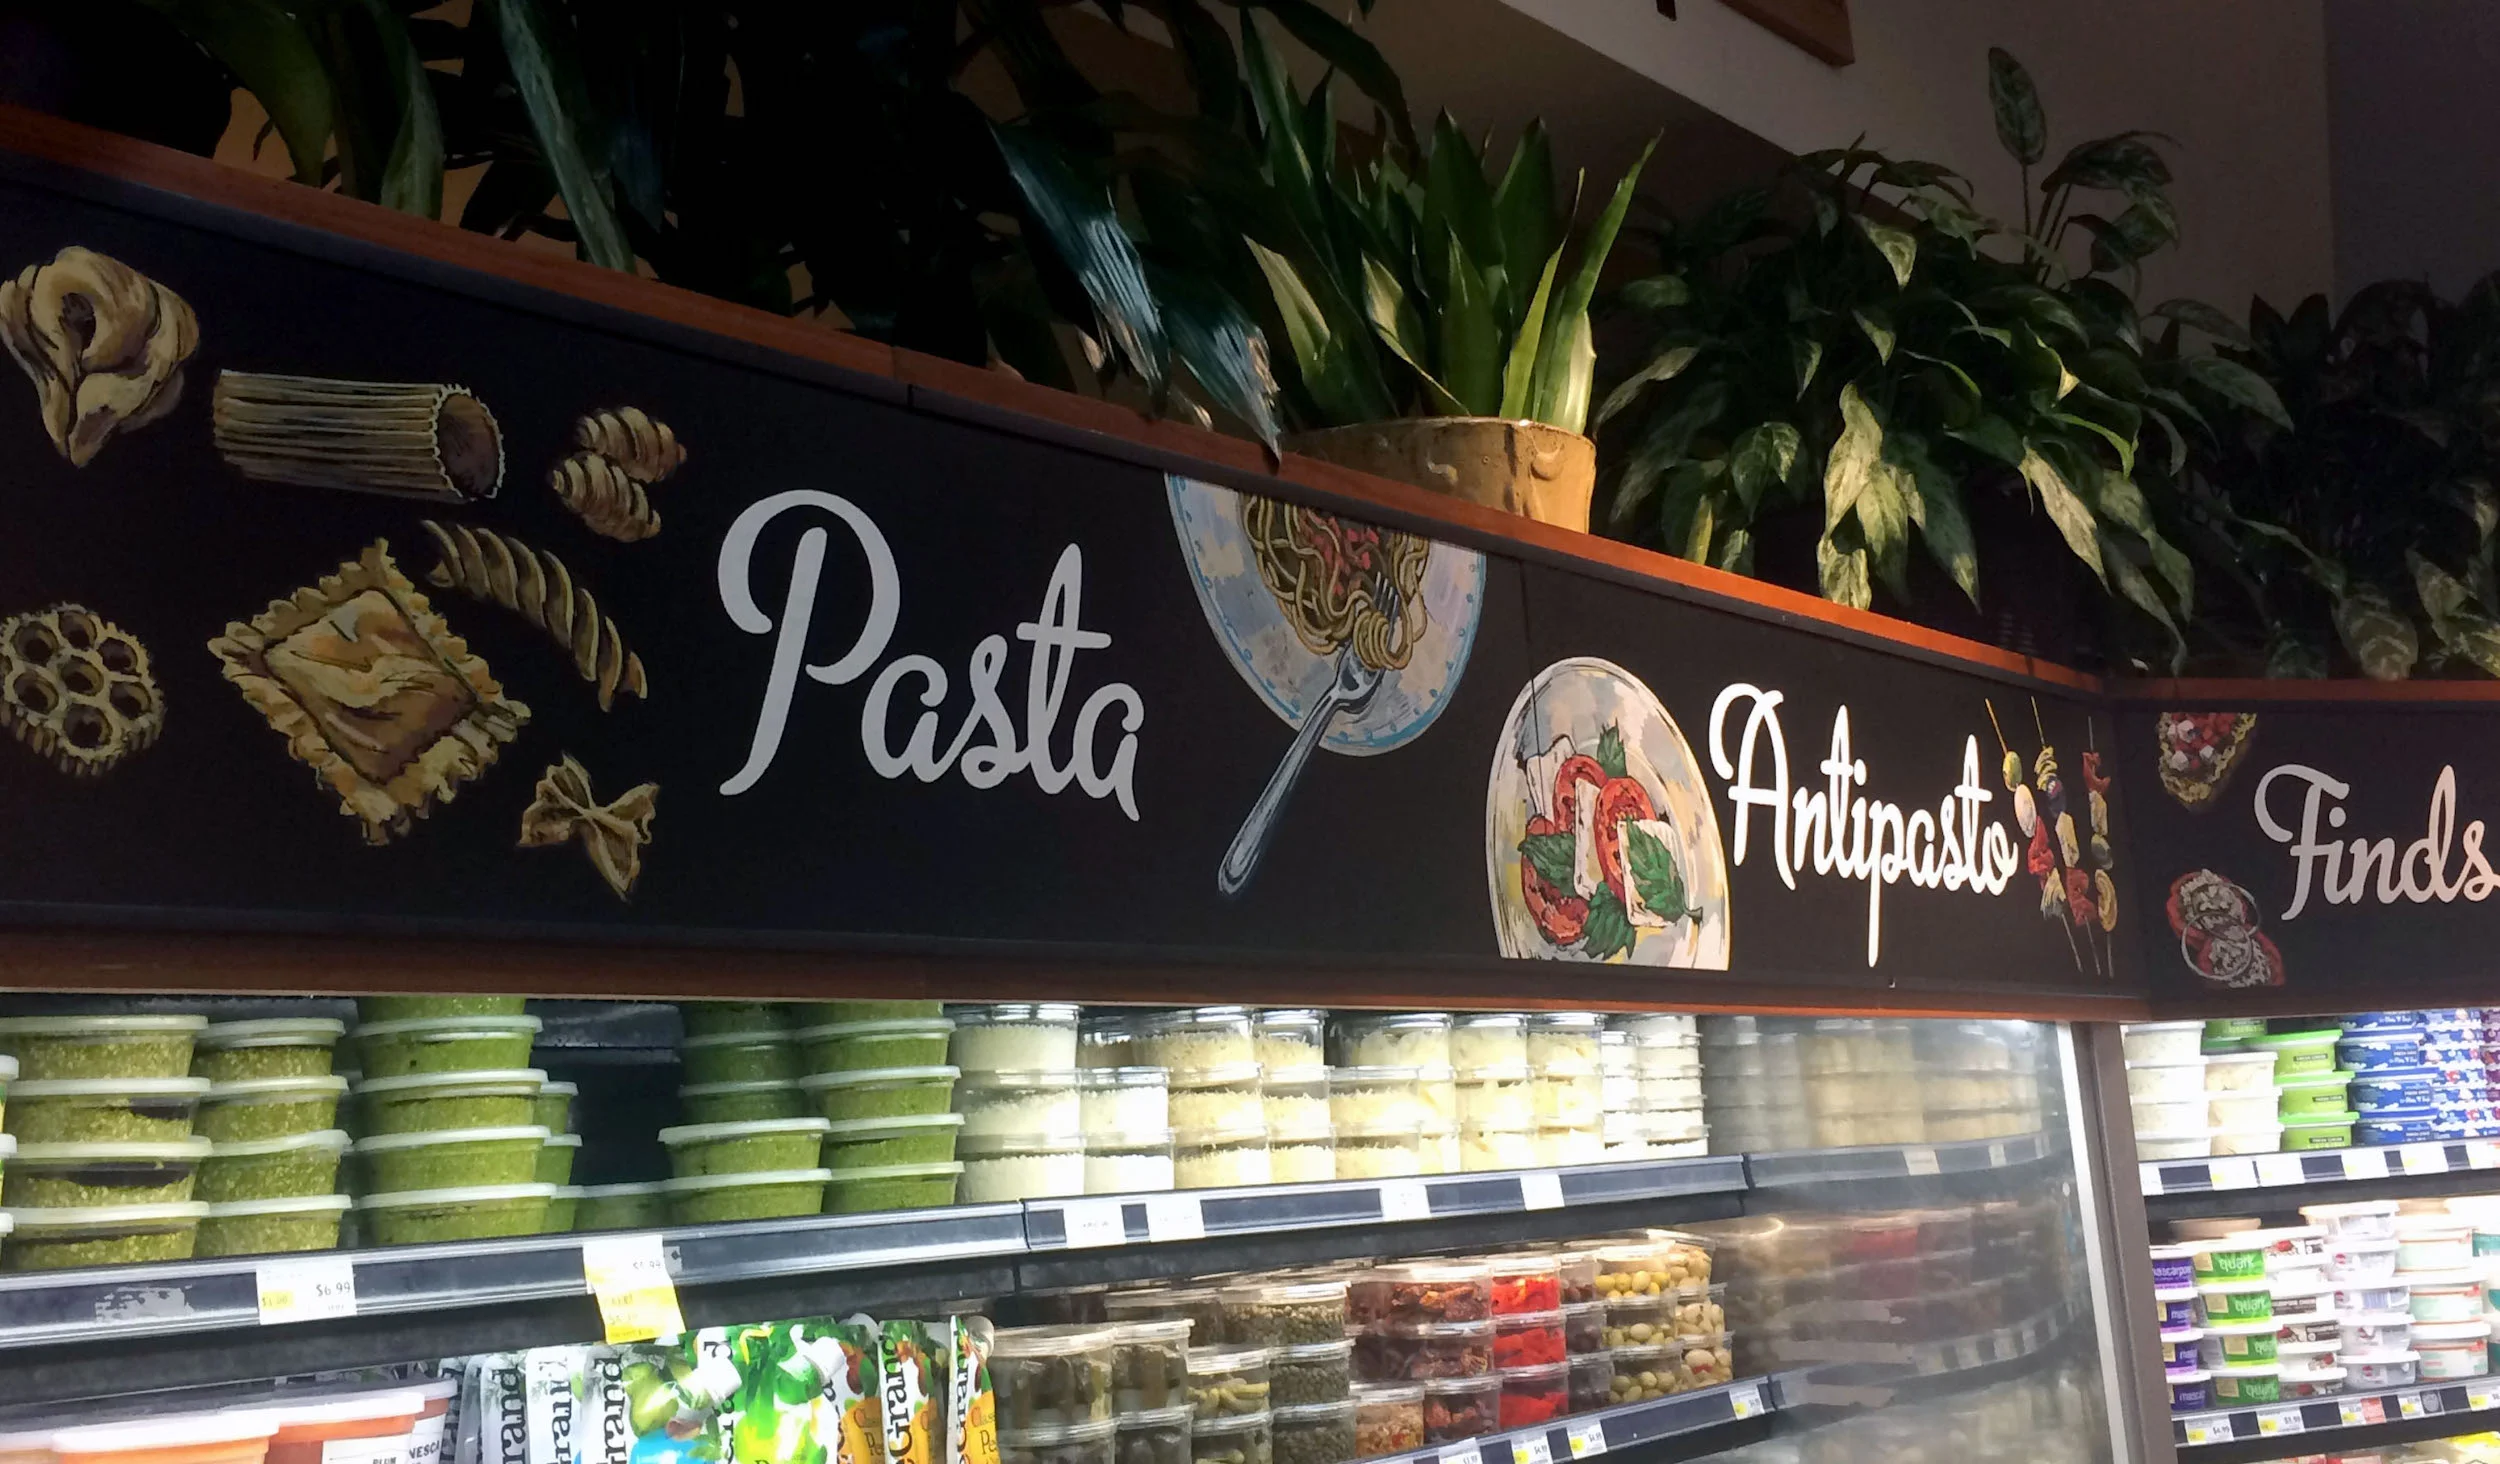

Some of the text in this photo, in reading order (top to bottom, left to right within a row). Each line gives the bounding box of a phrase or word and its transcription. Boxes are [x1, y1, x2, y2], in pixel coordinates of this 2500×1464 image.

[718, 489, 1145, 822] Pasta
[1709, 682, 2018, 967] Antipasto
[2254, 763, 2500, 921] Finds
